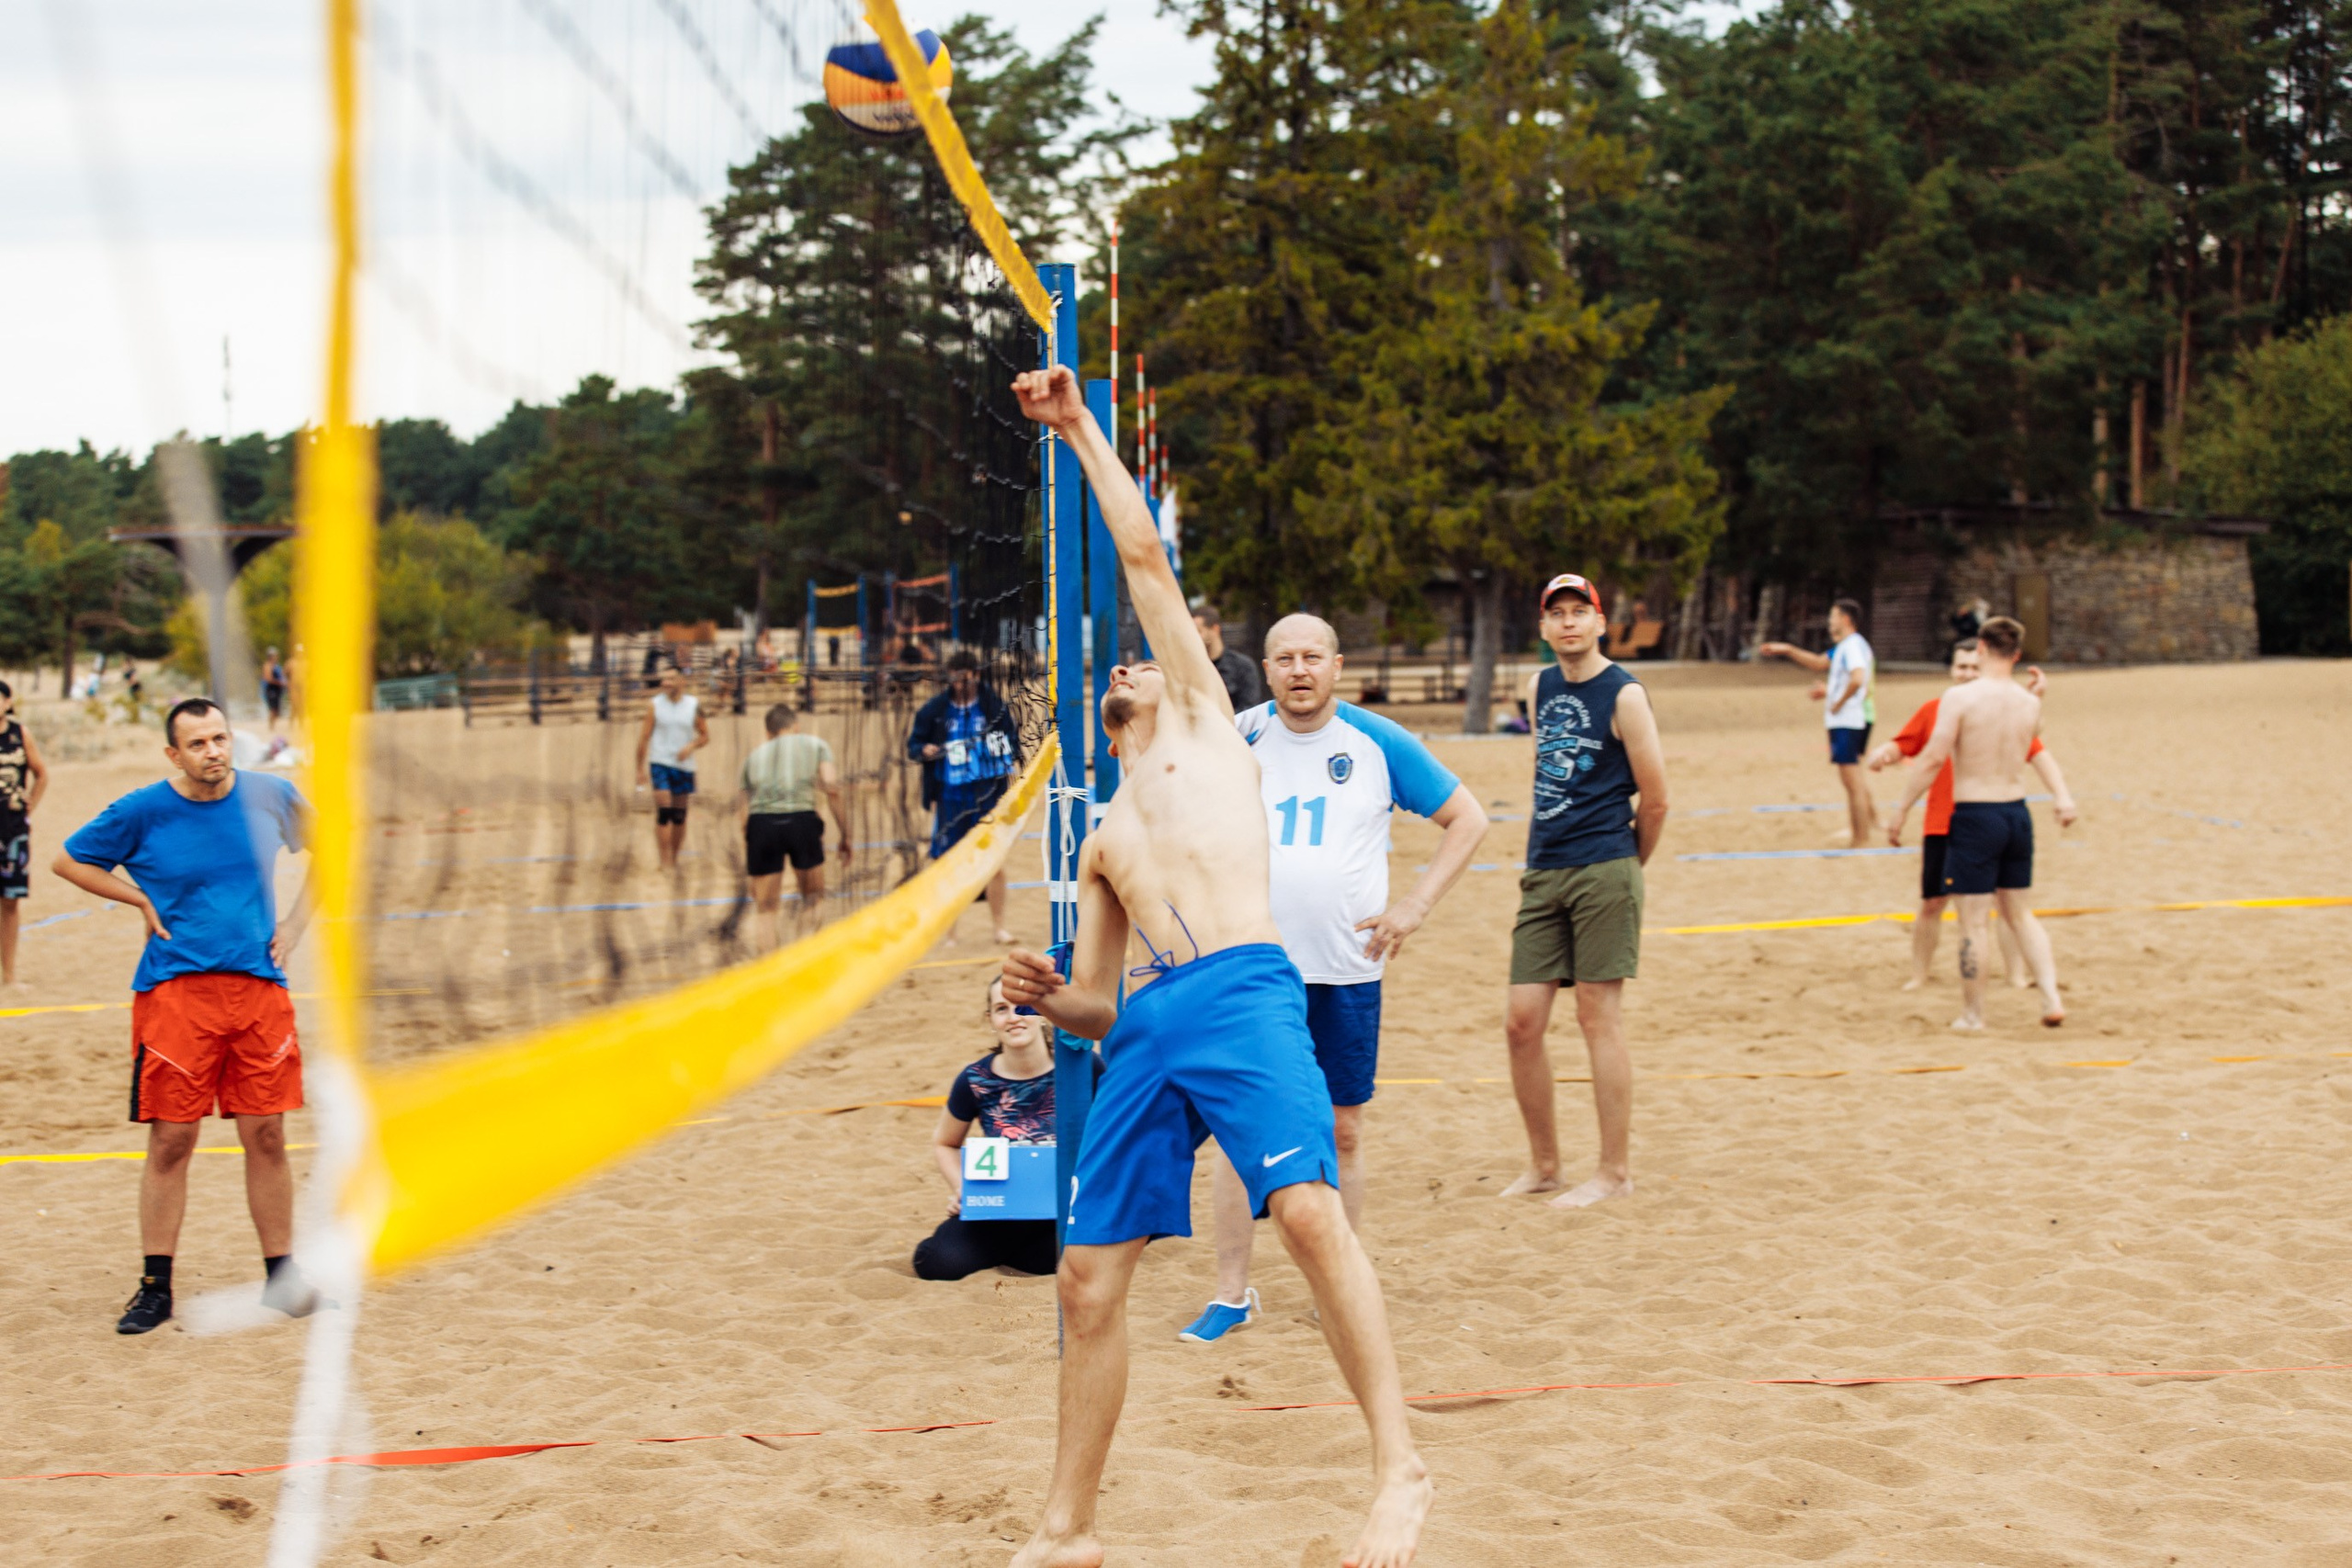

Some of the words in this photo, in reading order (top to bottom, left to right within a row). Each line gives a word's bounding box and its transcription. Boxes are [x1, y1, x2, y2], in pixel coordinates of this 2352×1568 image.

[1275, 795, 1327, 846] 11
[975, 1145, 998, 1177] 4
[966, 1195, 1006, 1207] HOME
